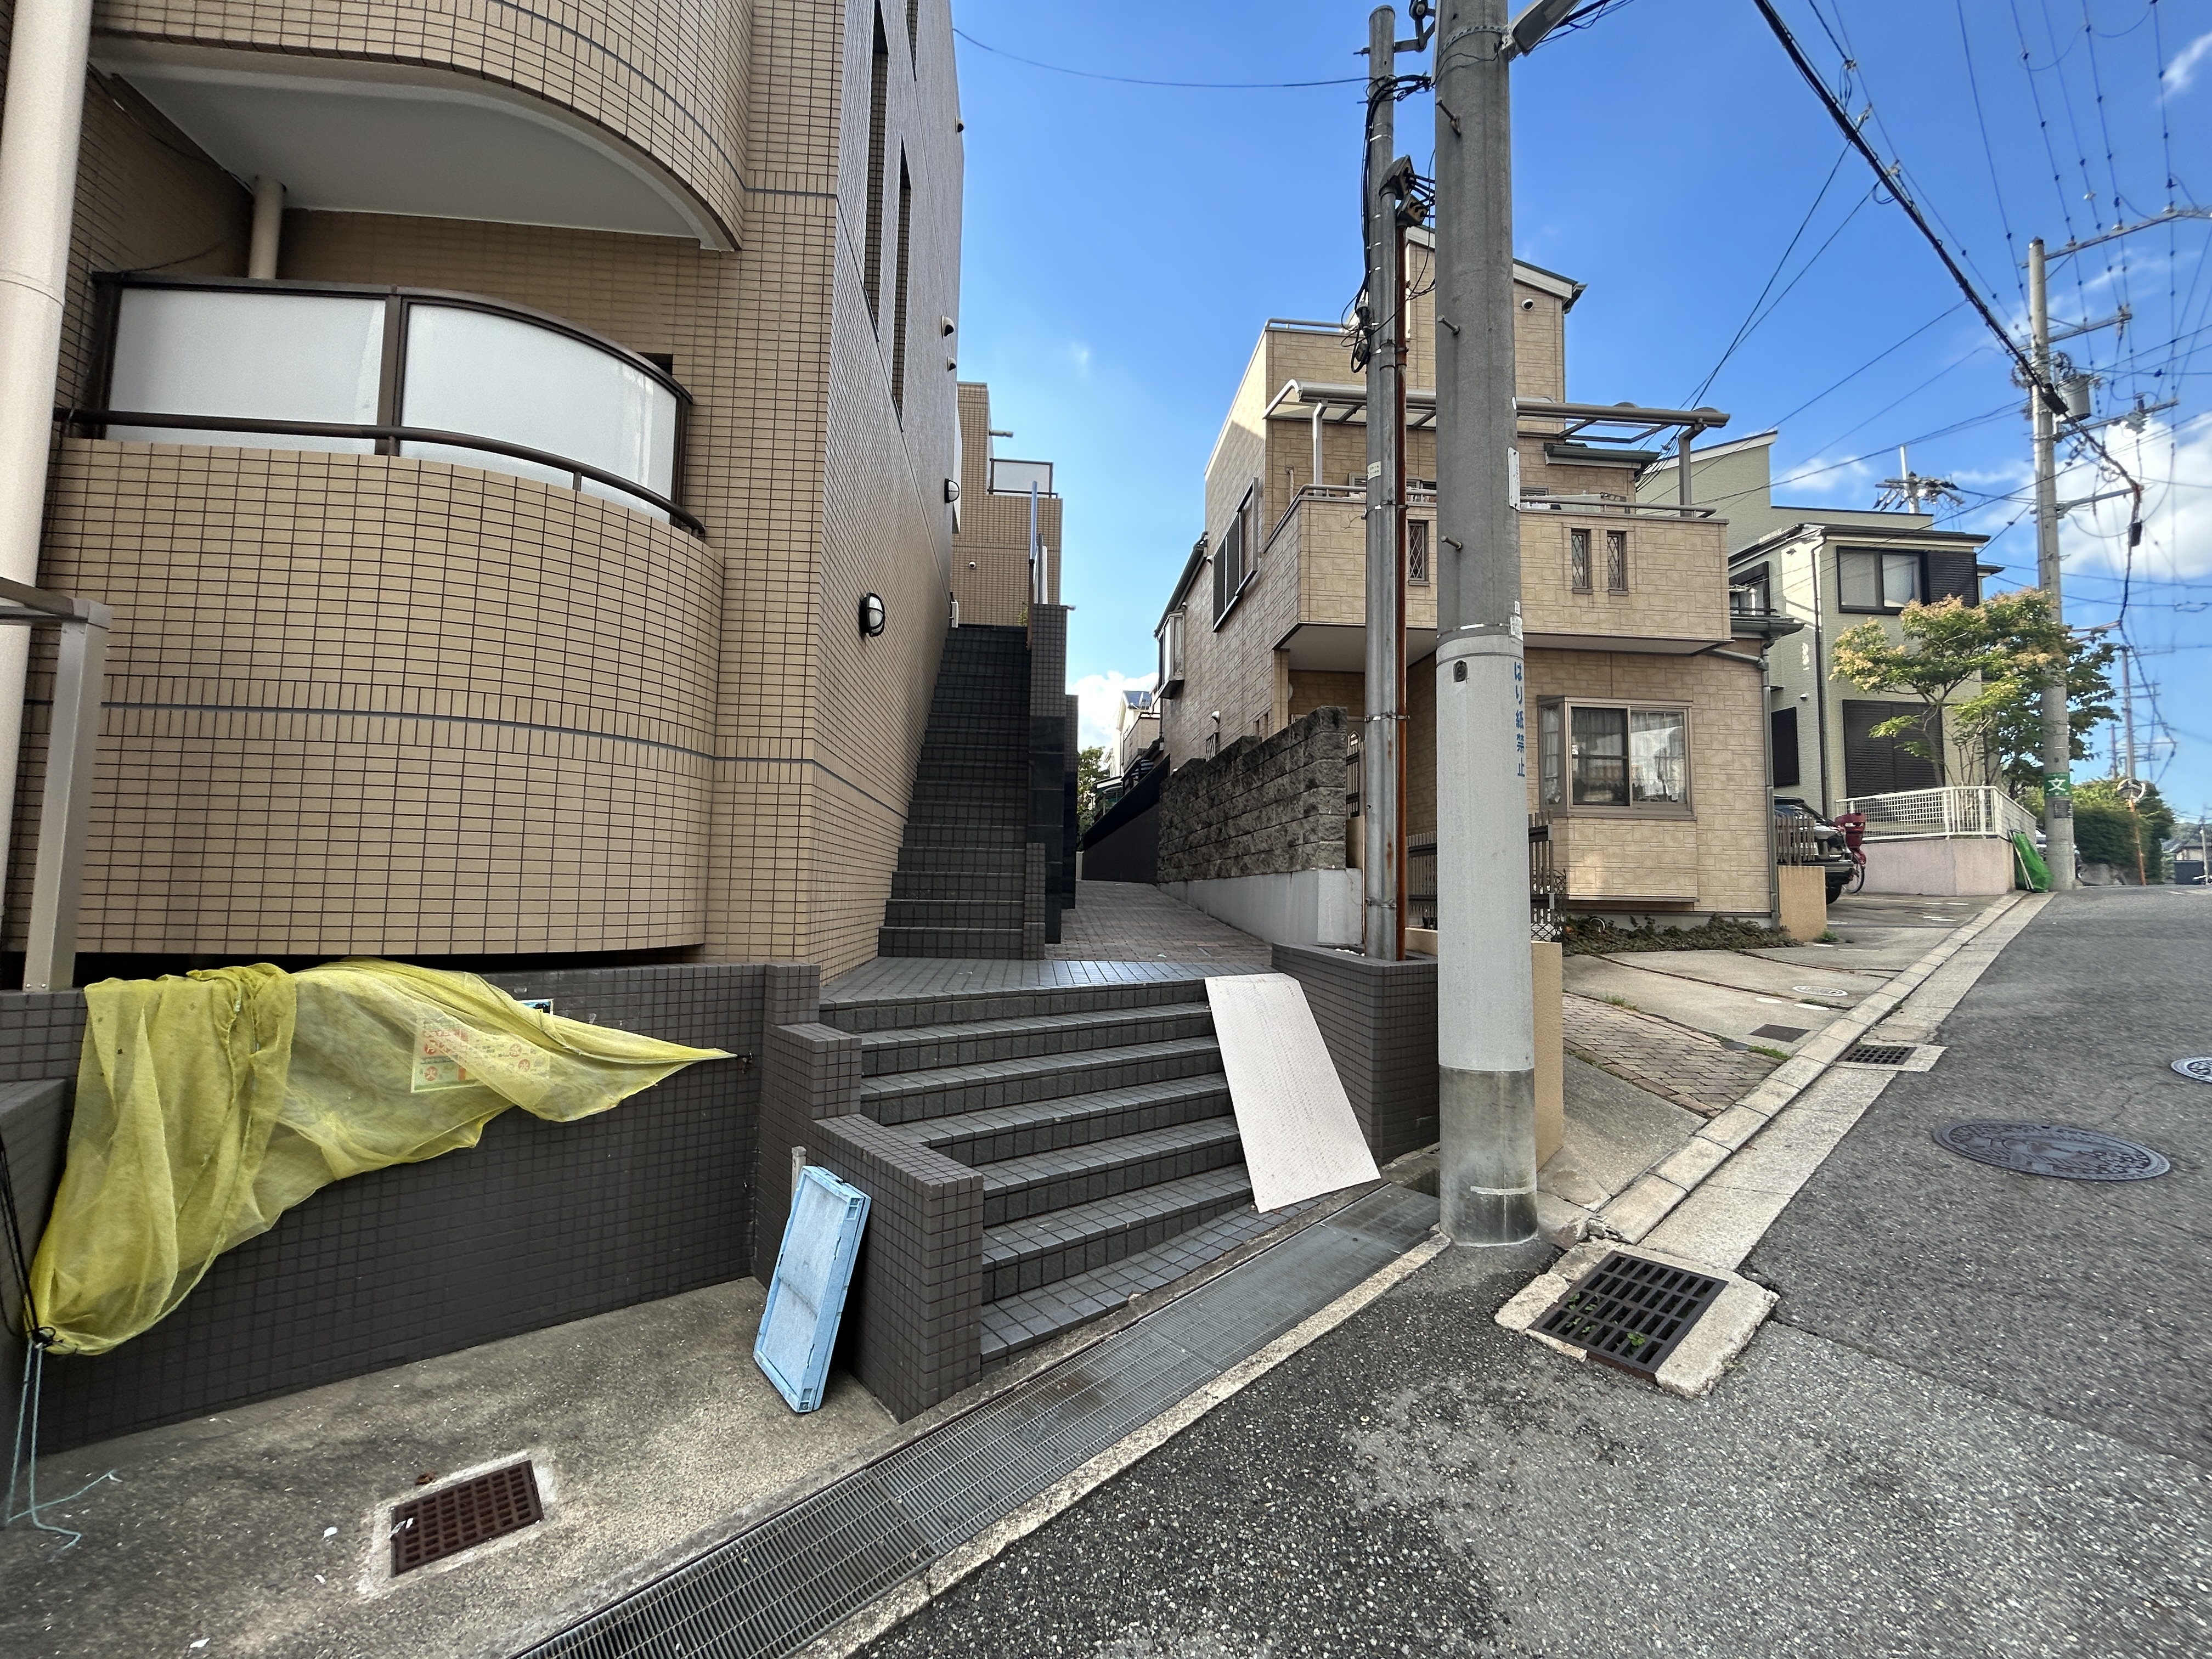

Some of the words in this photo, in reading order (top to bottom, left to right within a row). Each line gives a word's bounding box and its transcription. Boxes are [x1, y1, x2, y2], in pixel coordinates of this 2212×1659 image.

[1514, 661, 1525, 777] はり紙禁止
[2048, 778, 2067, 791] 文
